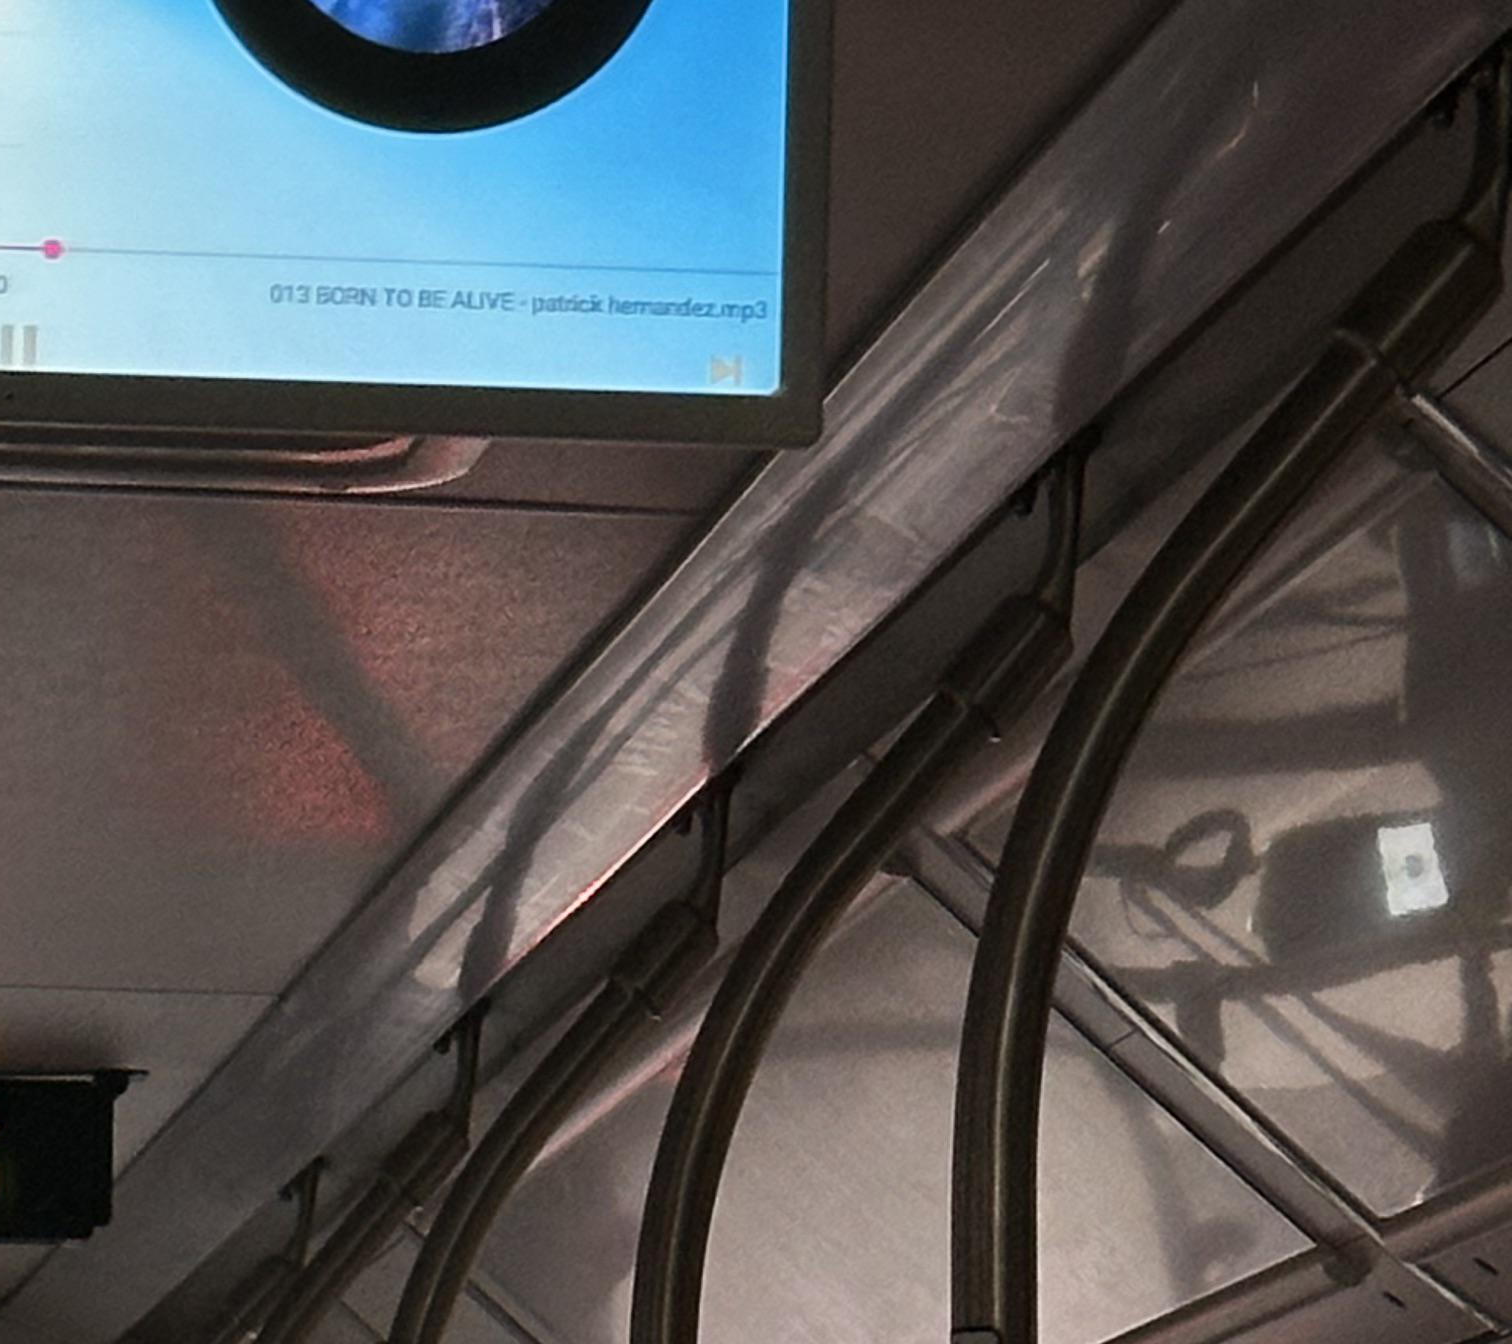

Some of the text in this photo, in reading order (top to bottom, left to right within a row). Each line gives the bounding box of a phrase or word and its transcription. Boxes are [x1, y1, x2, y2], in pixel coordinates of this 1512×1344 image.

[270, 284, 310, 305] 013
[316, 286, 377, 308] BORN
[385, 288, 413, 308] TO
[418, 289, 447, 309] BE
[451, 291, 515, 312] ALIVE
[532, 296, 604, 317] patrick
[608, 298, 767, 324] hernandez.mp3
